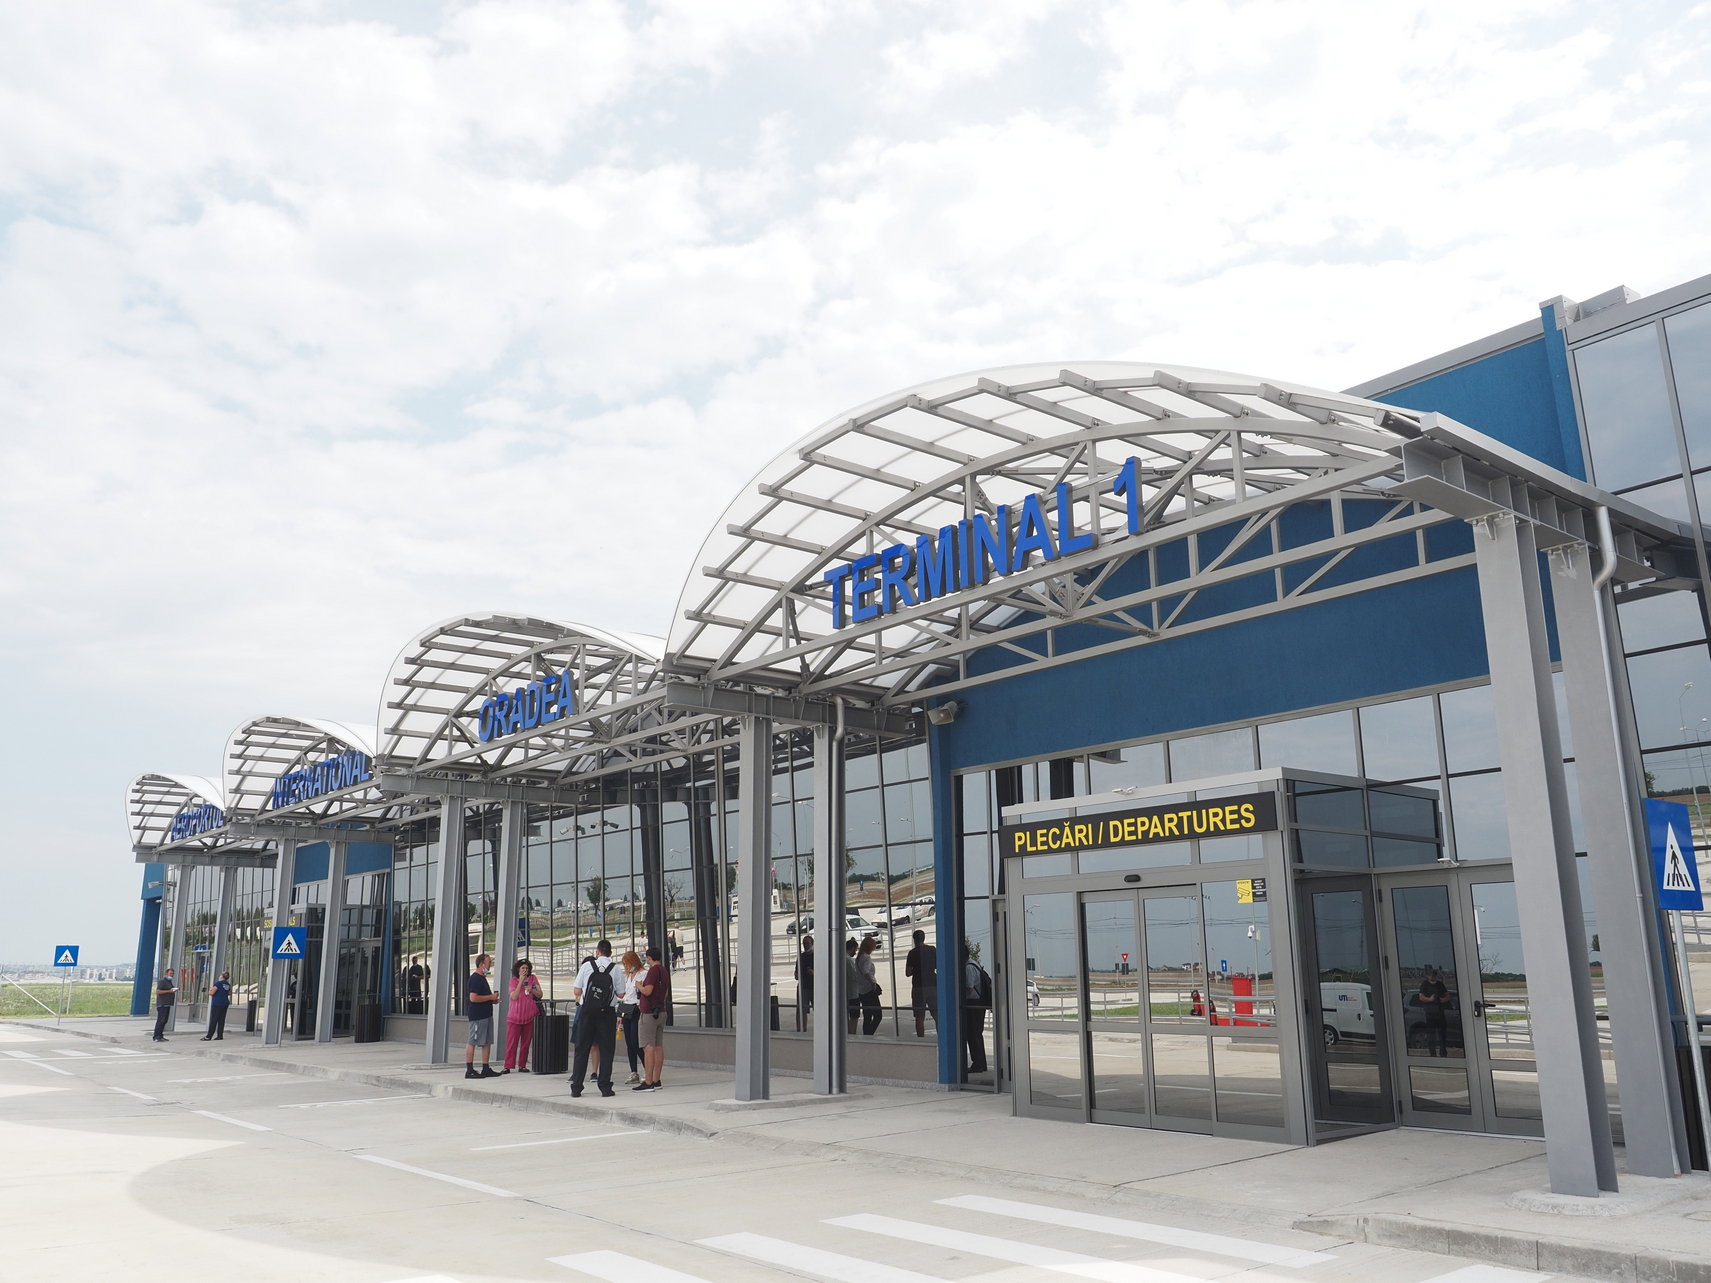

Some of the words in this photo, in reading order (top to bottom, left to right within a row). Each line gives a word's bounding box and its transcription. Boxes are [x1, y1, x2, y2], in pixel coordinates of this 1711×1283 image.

[824, 482, 1098, 629] TERMINAL
[1113, 456, 1145, 535] 1
[479, 669, 576, 742] ORADEA
[272, 749, 371, 810] INTERNATIONAL
[171, 803, 224, 842] AEROPORTUL
[1014, 821, 1093, 852] PLECĂRI
[1098, 822, 1104, 844] /
[1109, 803, 1256, 843] DEPARTURES
